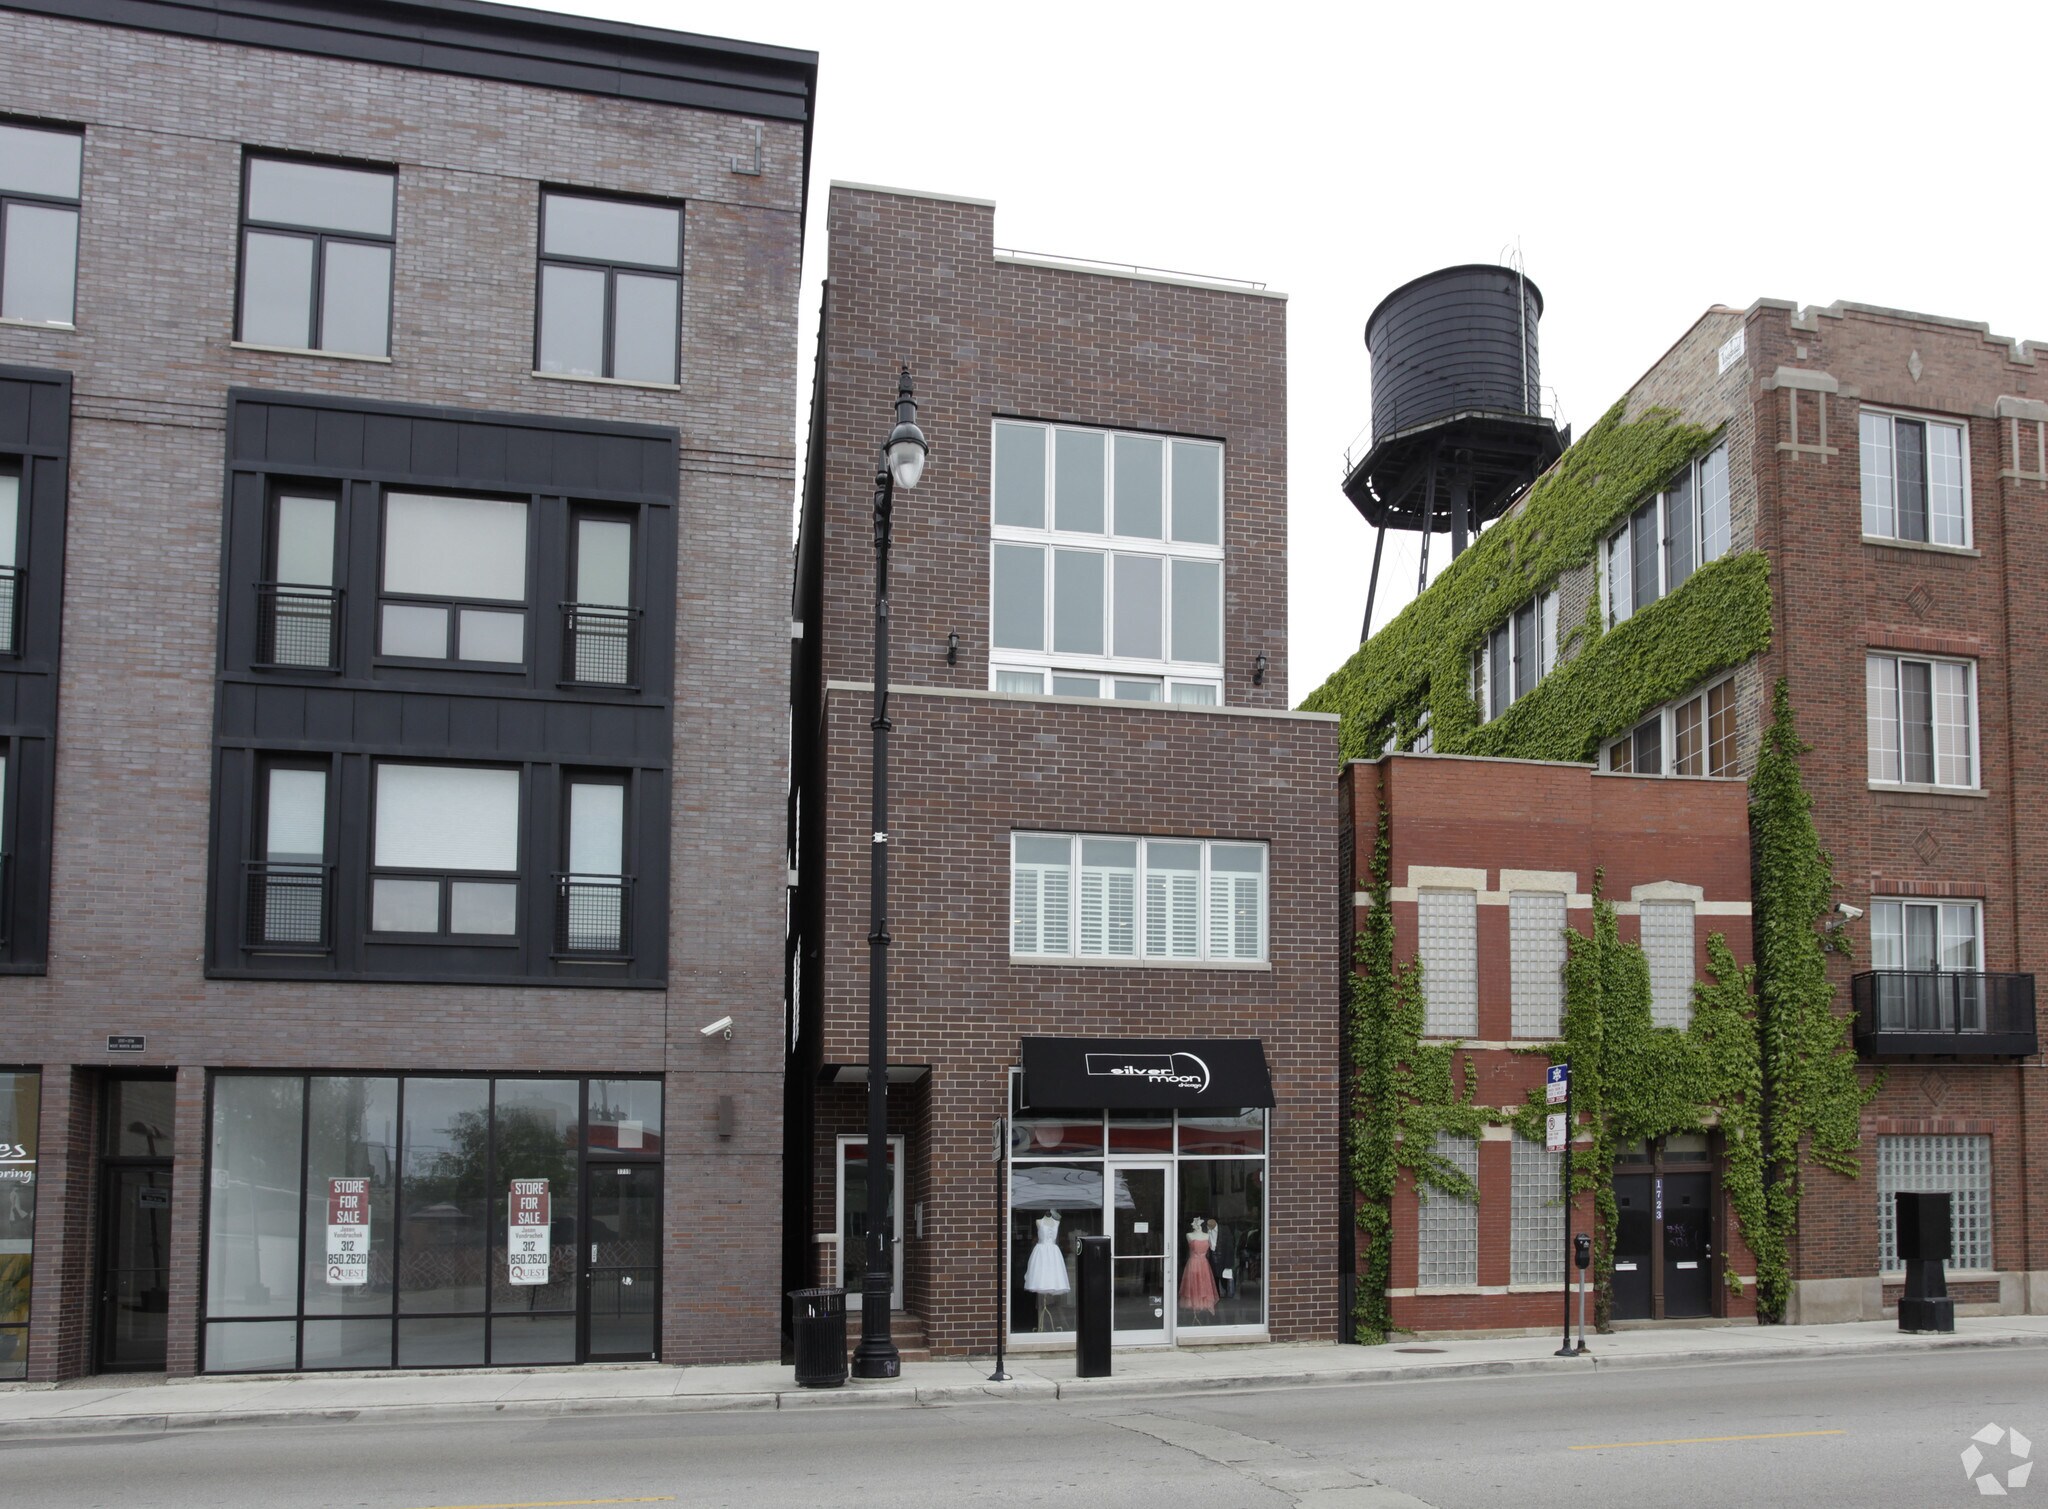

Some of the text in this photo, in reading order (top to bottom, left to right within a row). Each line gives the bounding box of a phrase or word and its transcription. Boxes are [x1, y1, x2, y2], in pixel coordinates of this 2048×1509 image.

[334, 1180, 364, 1193] STORE
[515, 1182, 544, 1195] STORE
[339, 1195, 358, 1208] FOR
[520, 1197, 538, 1210] FOR
[336, 1211, 360, 1224] SALE
[518, 1212, 541, 1225] SALE
[341, 1240, 355, 1252] 312
[522, 1241, 536, 1252] 312
[328, 1253, 367, 1265] 850.2620
[510, 1254, 547, 1265] 850.2620
[328, 1265, 365, 1281] QUEST
[511, 1265, 547, 1281] QUEST
